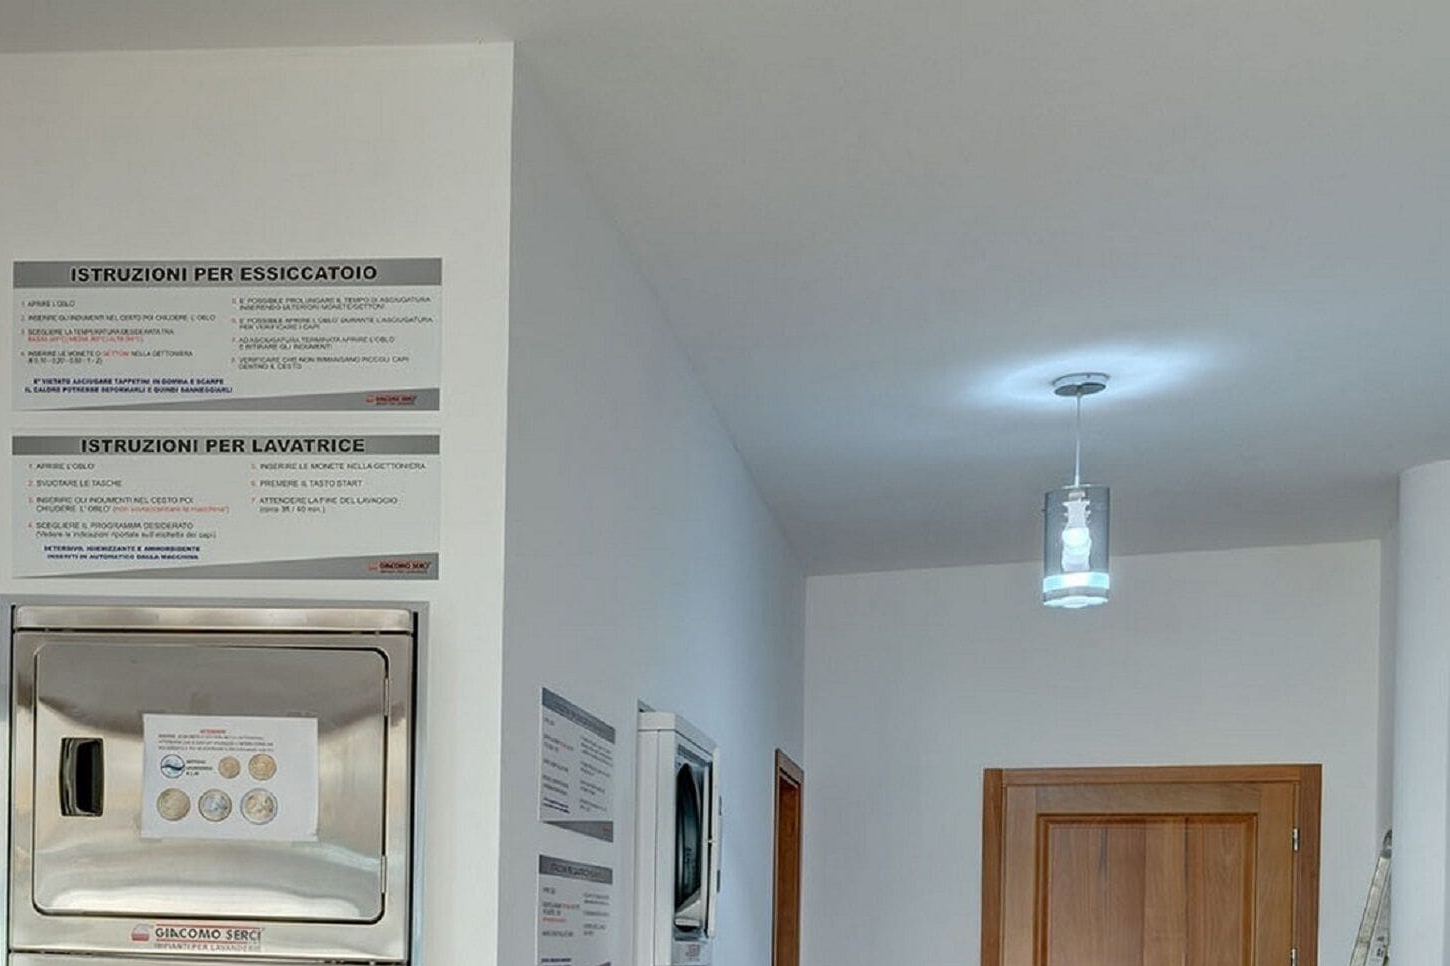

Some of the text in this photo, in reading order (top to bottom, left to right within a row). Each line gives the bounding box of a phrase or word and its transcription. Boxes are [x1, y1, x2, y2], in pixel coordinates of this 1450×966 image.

[71, 266, 378, 282] ISTRUZIONI PER ESSICCATOIO
[81, 438, 365, 453] ISTRUZIONI PER LAVATRICE
[155, 928, 262, 941] GIACOMO SERCI
